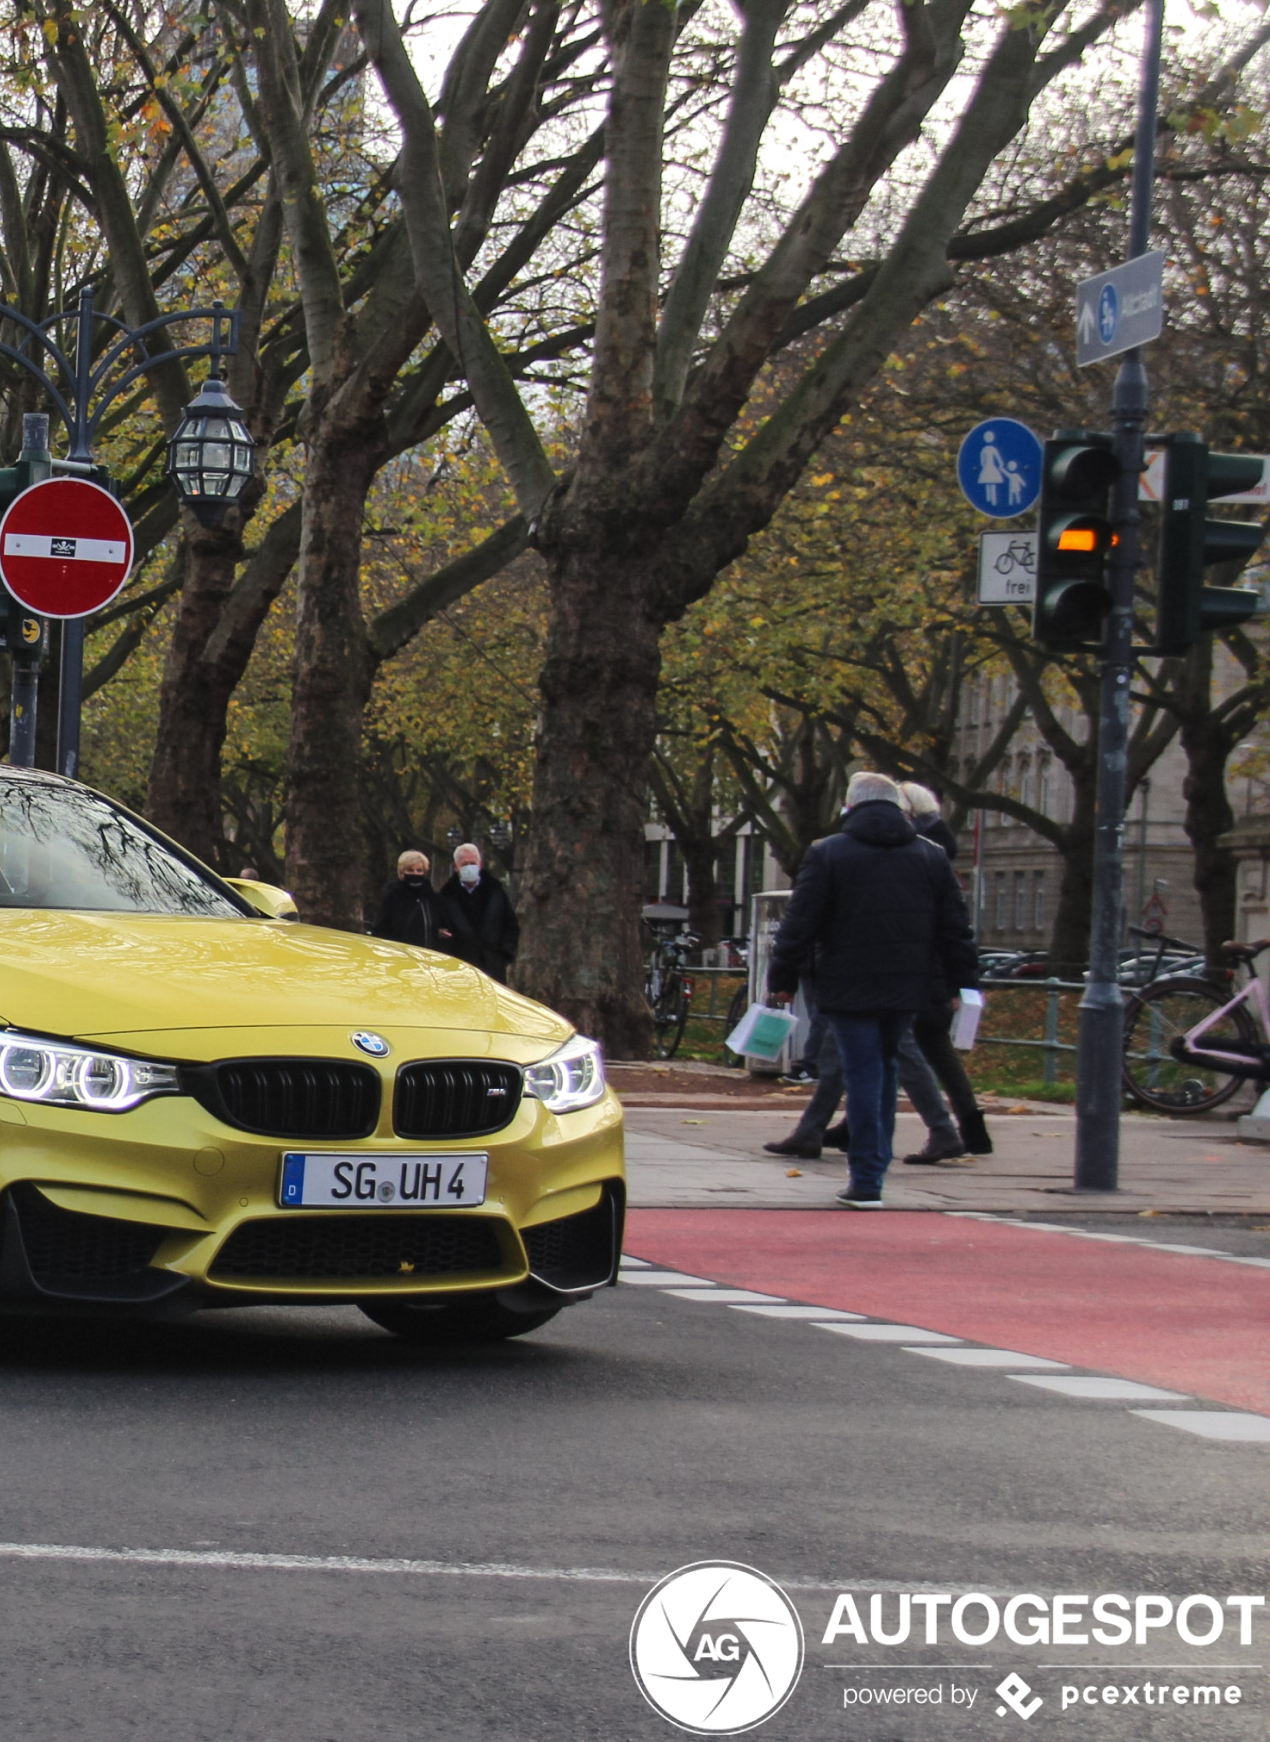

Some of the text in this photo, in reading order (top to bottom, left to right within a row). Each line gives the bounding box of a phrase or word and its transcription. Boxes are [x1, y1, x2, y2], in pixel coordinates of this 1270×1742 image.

[1005, 579, 1031, 595] frei
[331, 1161, 465, 1200] SG UH 4
[288, 1185, 296, 1196] D
